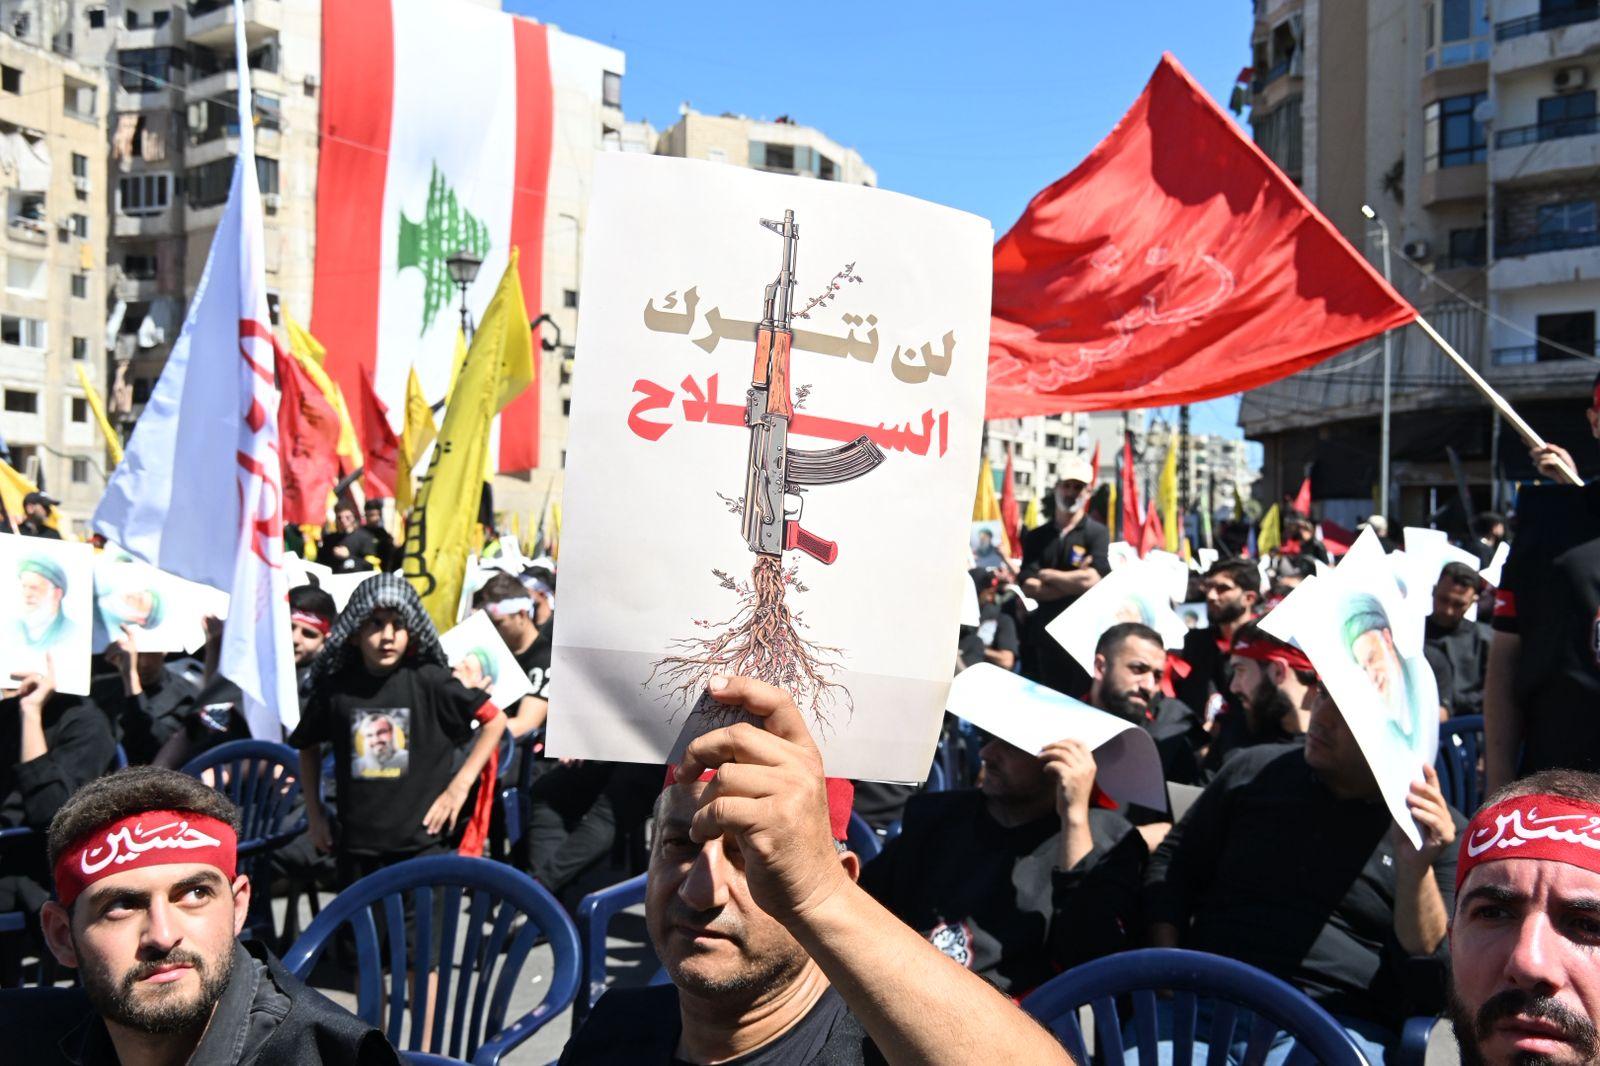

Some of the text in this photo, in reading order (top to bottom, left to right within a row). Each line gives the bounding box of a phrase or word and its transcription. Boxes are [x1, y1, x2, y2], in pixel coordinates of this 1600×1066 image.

[643, 286, 957, 384] لن نترك
[627, 373, 949, 458] السلاح
[1467, 806, 1600, 858] سين
